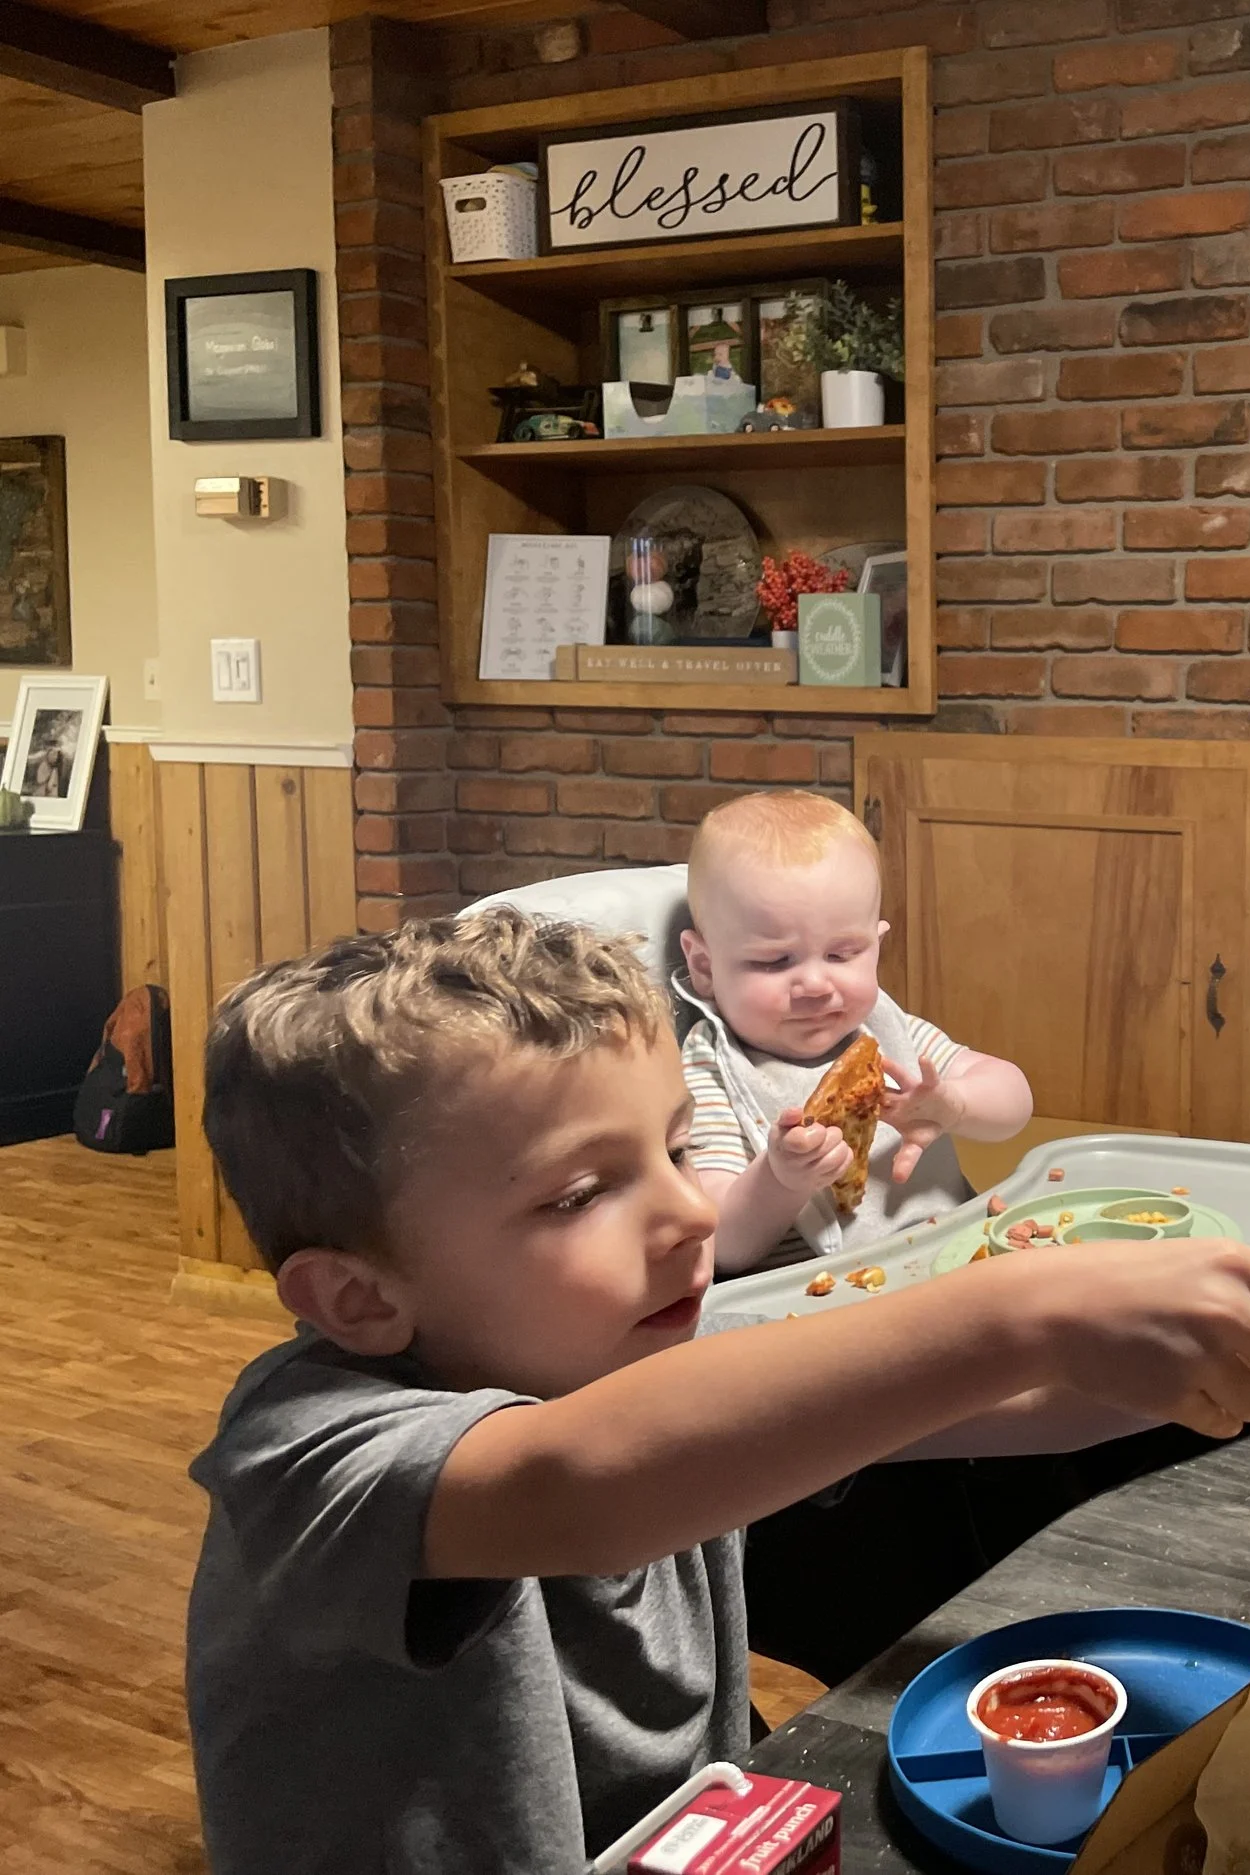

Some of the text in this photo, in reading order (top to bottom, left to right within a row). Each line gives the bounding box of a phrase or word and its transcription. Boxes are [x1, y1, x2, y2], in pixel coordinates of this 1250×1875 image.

[550, 121, 838, 230] blessed
[815, 624, 847, 642] cuddle
[808, 641, 854, 657] WEATHER
[586, 657, 611, 668] EAT
[618, 657, 655, 669] WELL
[676, 660, 730, 671] TRAVEL
[735, 660, 782, 672] OFTEN
[738, 1840, 780, 1873] fruit
[772, 1803, 817, 1843] punch
